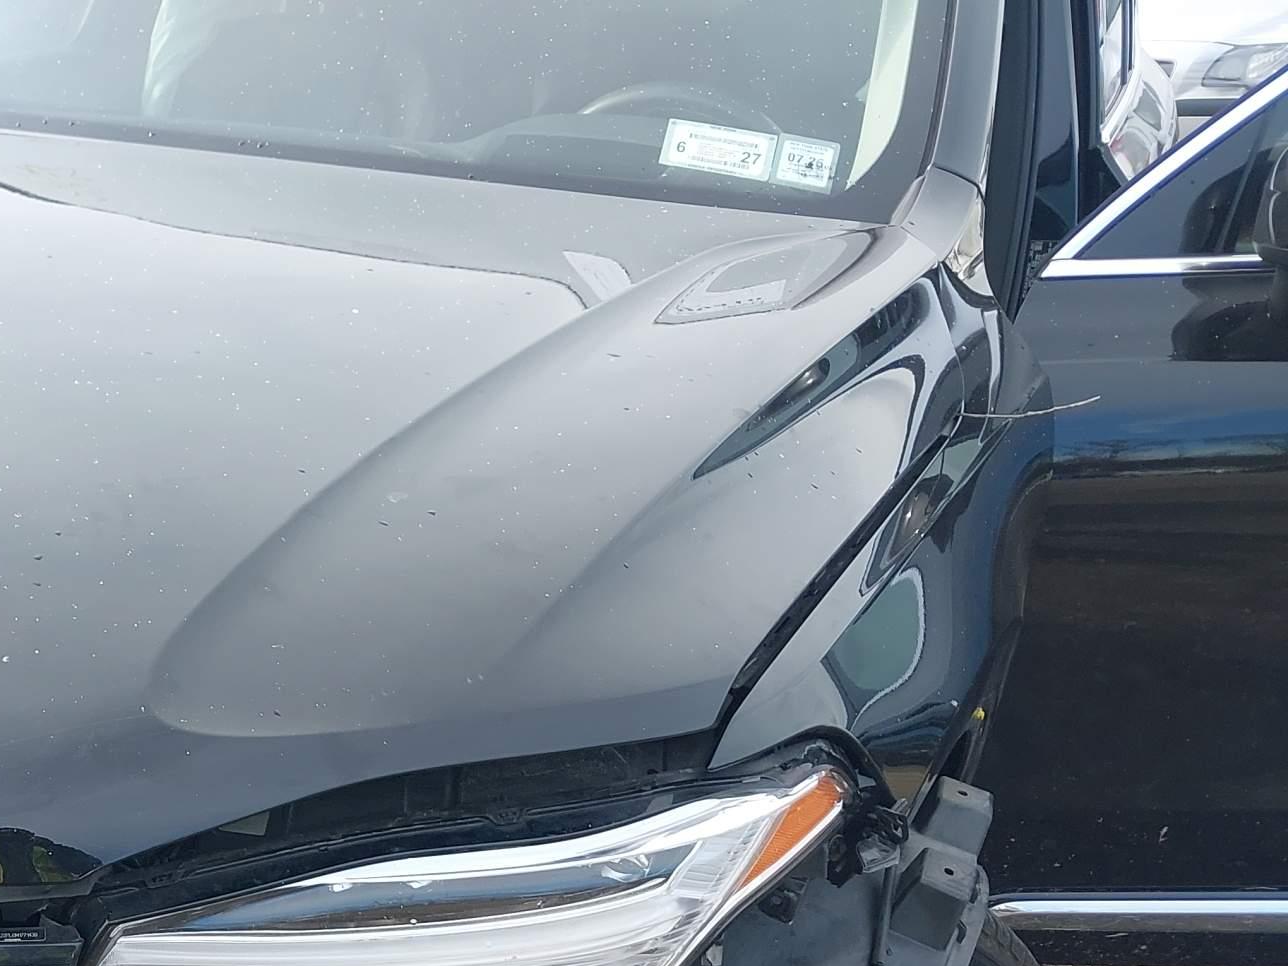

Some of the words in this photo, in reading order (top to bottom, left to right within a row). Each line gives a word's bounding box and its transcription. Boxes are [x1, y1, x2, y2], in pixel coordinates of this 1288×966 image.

[676, 140, 686, 153] 6
[741, 151, 762, 166] 27
[787, 152, 804, 163] 07
